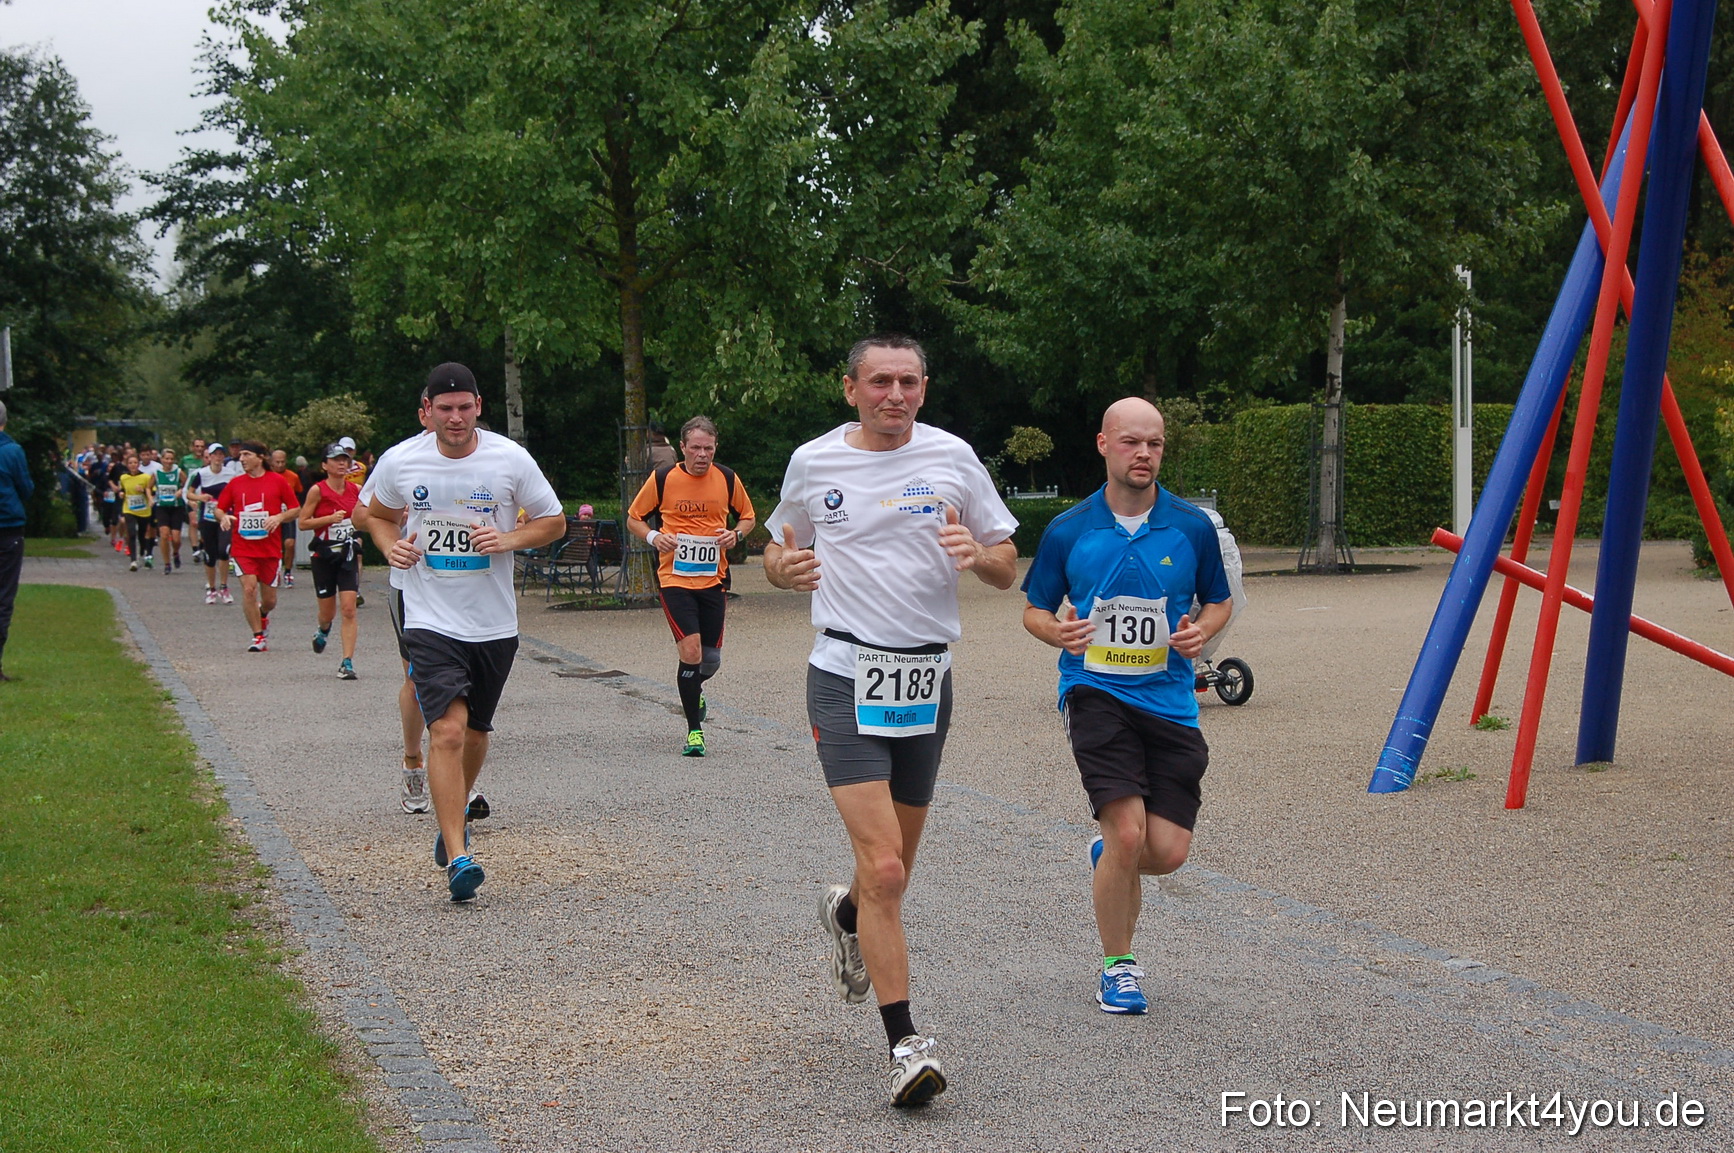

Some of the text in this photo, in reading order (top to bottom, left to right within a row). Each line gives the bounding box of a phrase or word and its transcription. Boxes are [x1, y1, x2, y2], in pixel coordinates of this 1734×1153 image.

[428, 530, 480, 552] 249
[678, 544, 716, 562] 3100
[445, 558, 467, 568] Felix
[1118, 604, 1158, 613] Neumarkt
[1105, 614, 1156, 645] 130
[858, 654, 932, 663] PARTL Neumarkt
[1106, 650, 1150, 664] Andreas
[866, 667, 936, 701] 2183
[884, 710, 917, 724] Martin
